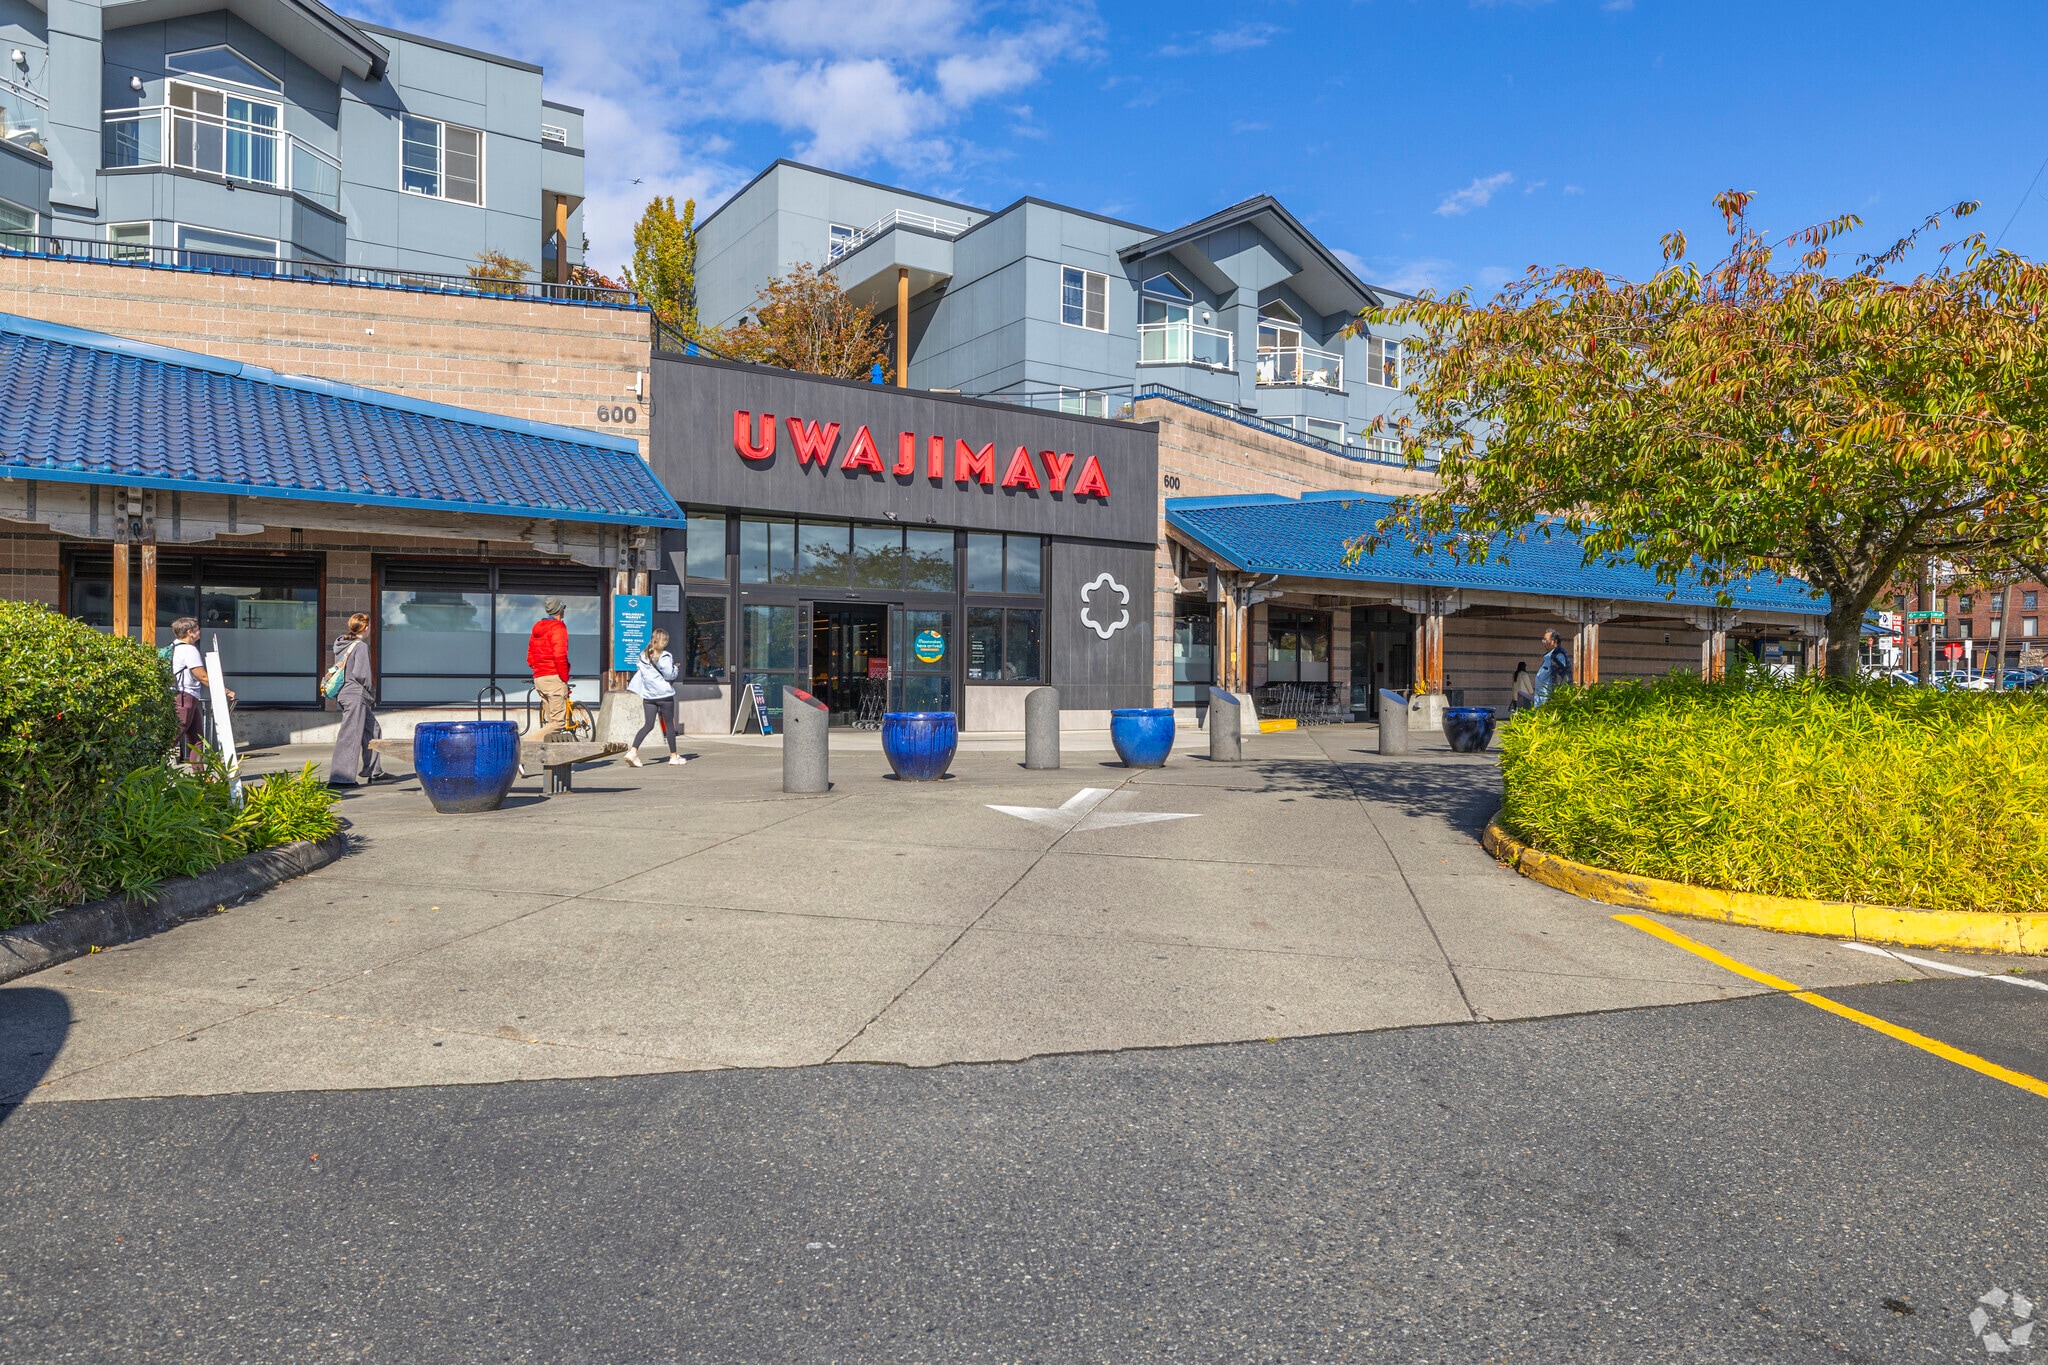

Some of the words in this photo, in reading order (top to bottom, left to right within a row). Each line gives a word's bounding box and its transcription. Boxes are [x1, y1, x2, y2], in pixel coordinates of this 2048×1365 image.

[597, 405, 637, 425] 600
[733, 409, 1111, 498] UWAJIMAYA
[1164, 474, 1180, 490] 600
